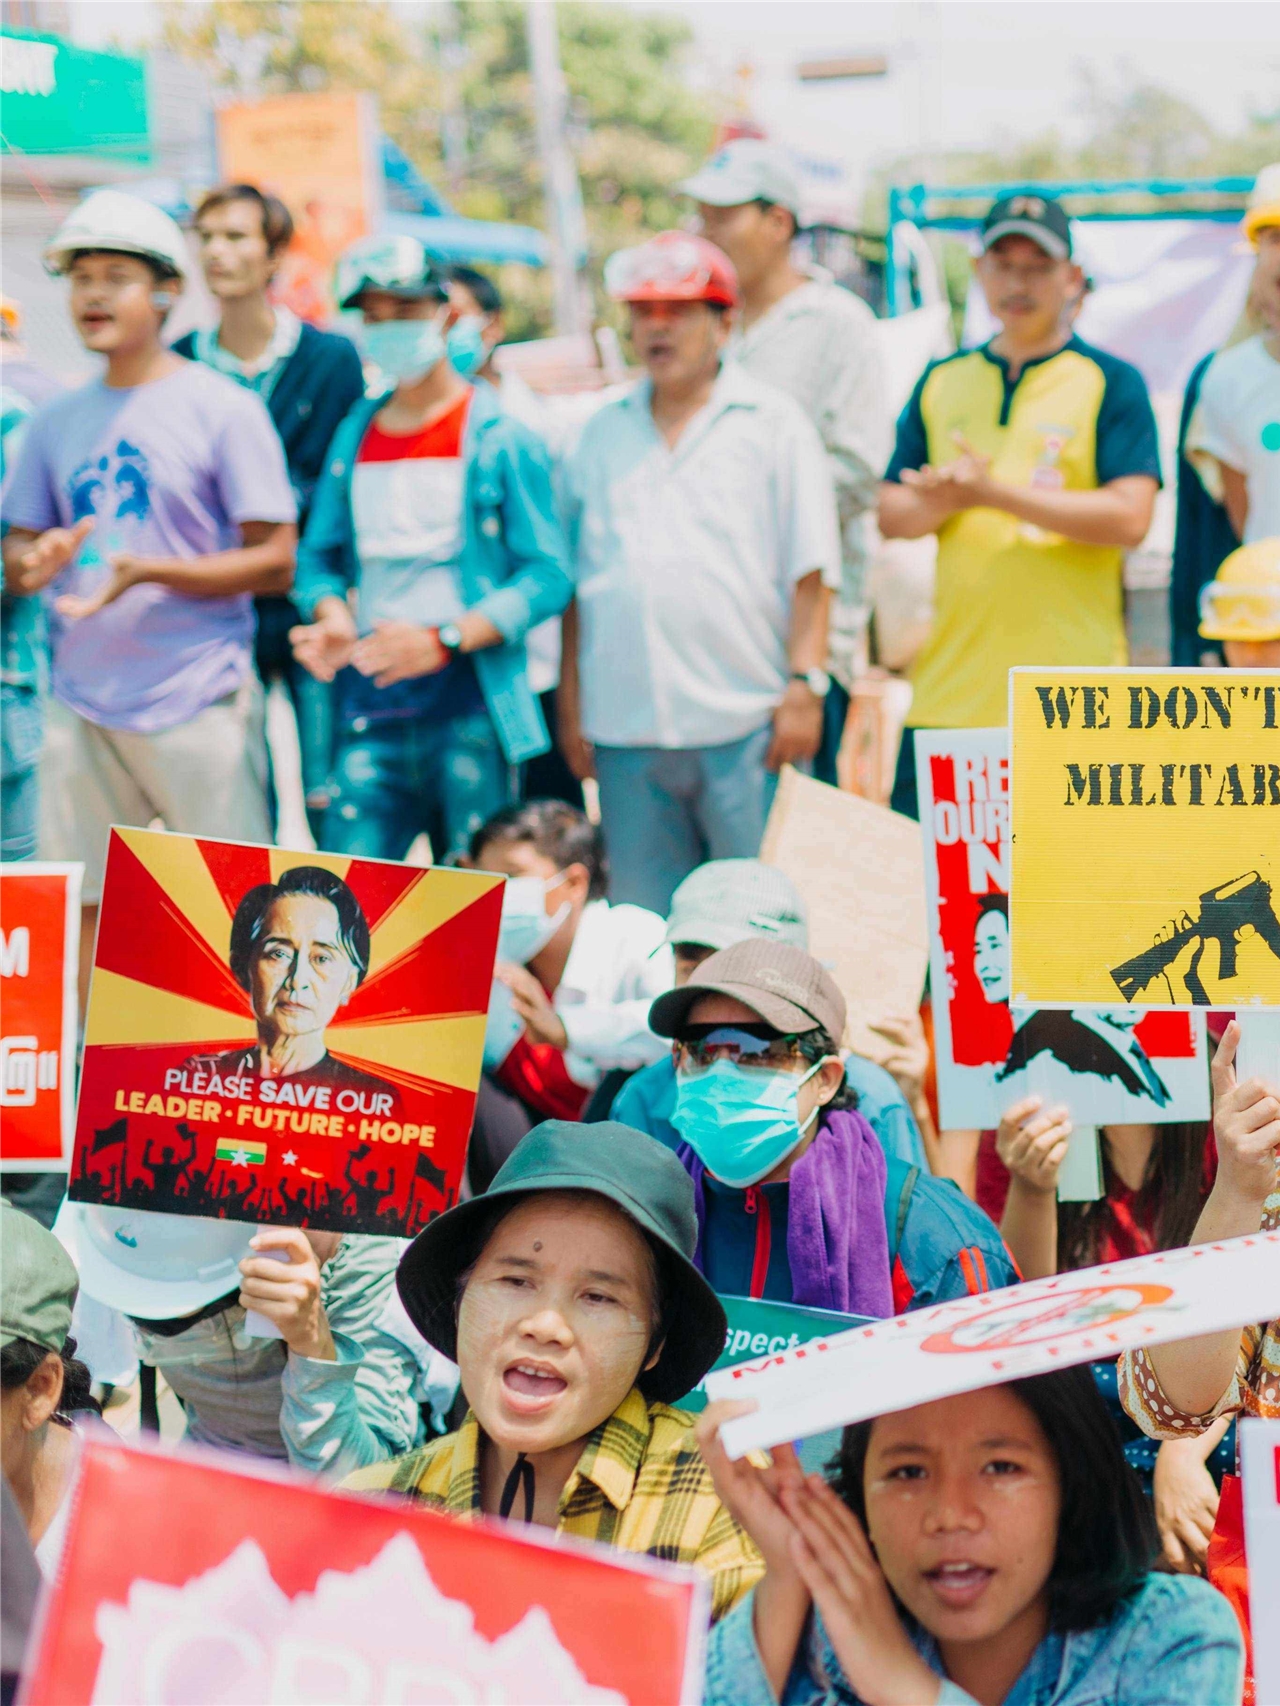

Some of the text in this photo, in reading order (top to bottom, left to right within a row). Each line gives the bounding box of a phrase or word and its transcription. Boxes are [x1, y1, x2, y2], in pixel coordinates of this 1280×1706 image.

[1036, 687, 1110, 729] WE
[164, 1068, 394, 1117] PLEASE SAVE OUR
[115, 1089, 436, 1148] LEADER FUTURE HOPE
